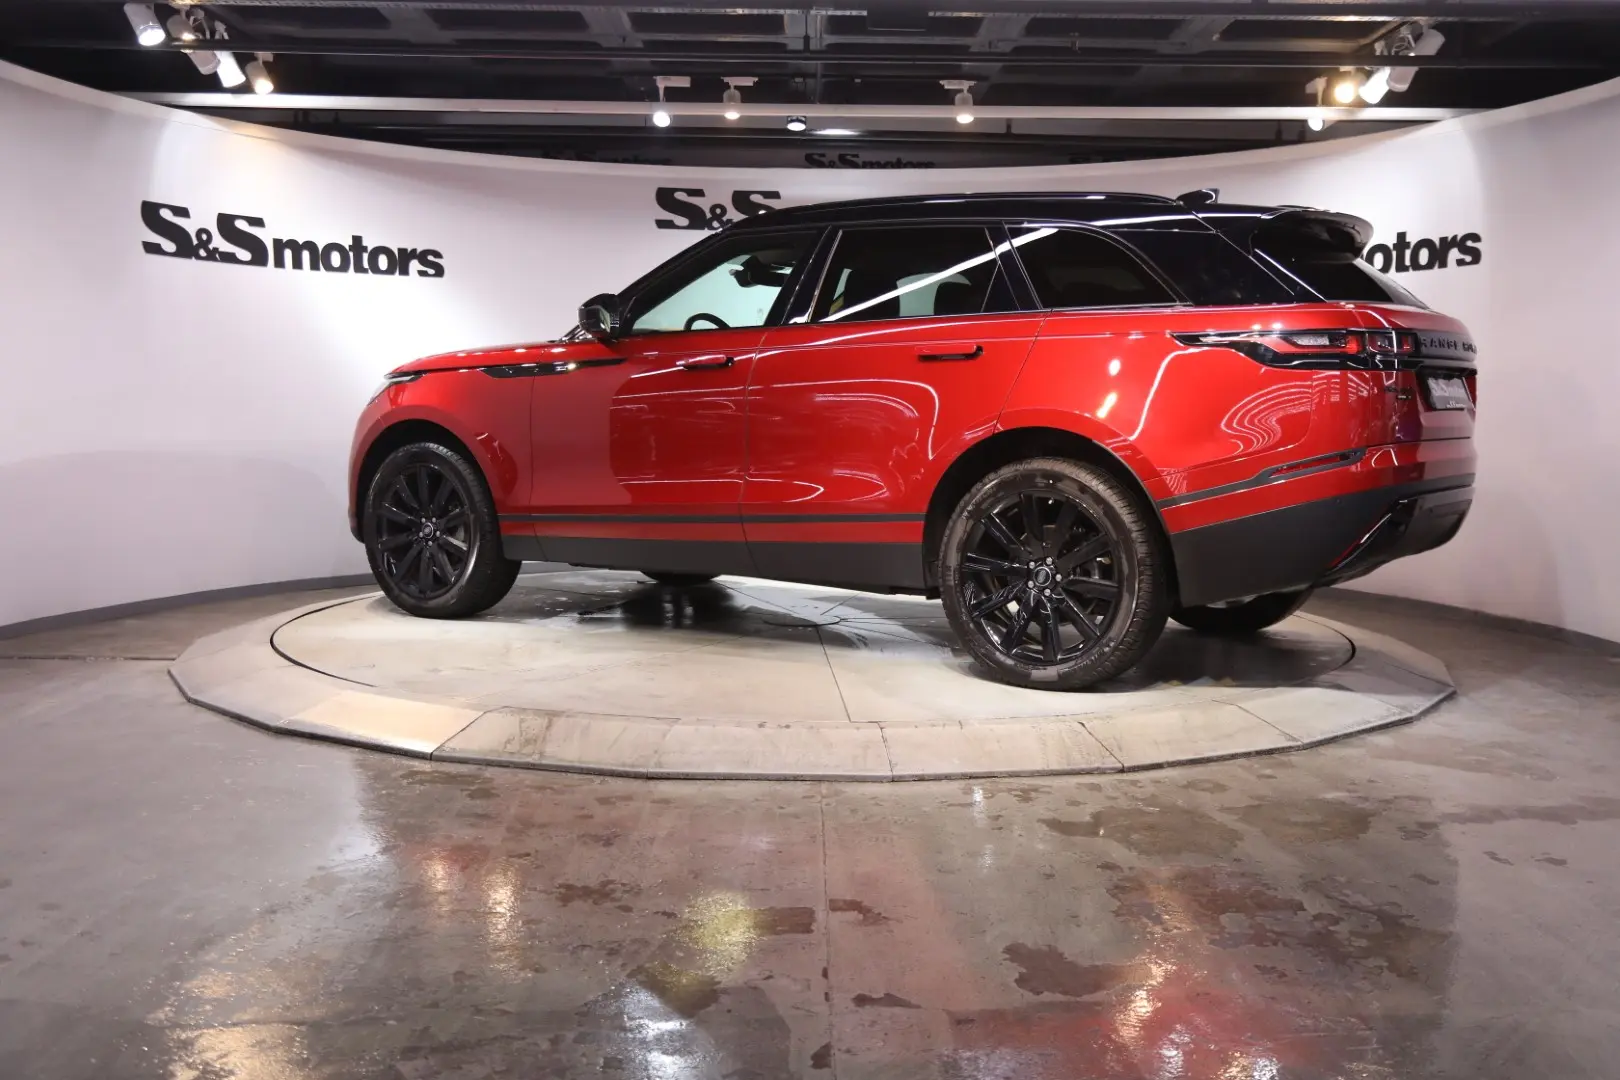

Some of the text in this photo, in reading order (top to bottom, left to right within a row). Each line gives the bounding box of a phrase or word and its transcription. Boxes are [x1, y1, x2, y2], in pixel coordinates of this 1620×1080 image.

[141, 200, 445, 278] S&S motors
[1361, 231, 1482, 275] otors
